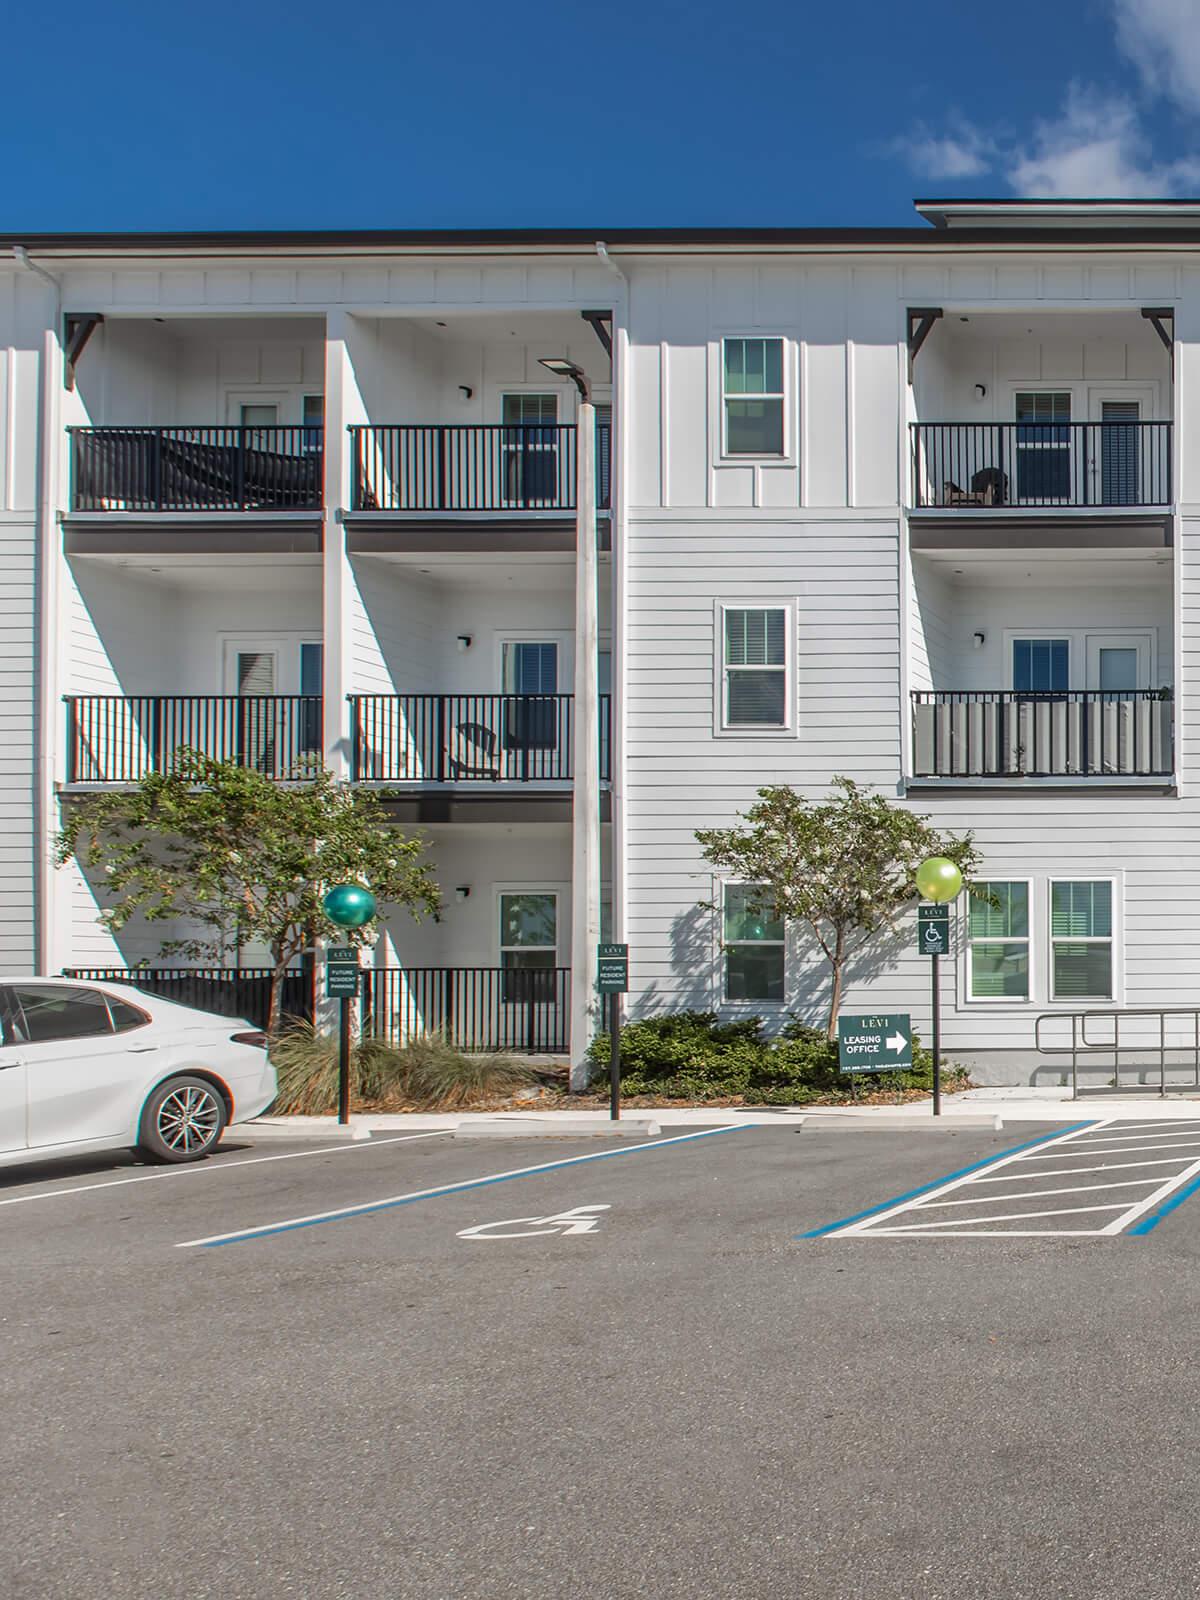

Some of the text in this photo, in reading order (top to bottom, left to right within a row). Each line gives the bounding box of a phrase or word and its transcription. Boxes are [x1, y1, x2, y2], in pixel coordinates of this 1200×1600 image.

[862, 1018, 889, 1028] LEVI
[843, 1035, 881, 1045] LEASING
[846, 1045, 880, 1054] OFFICE
